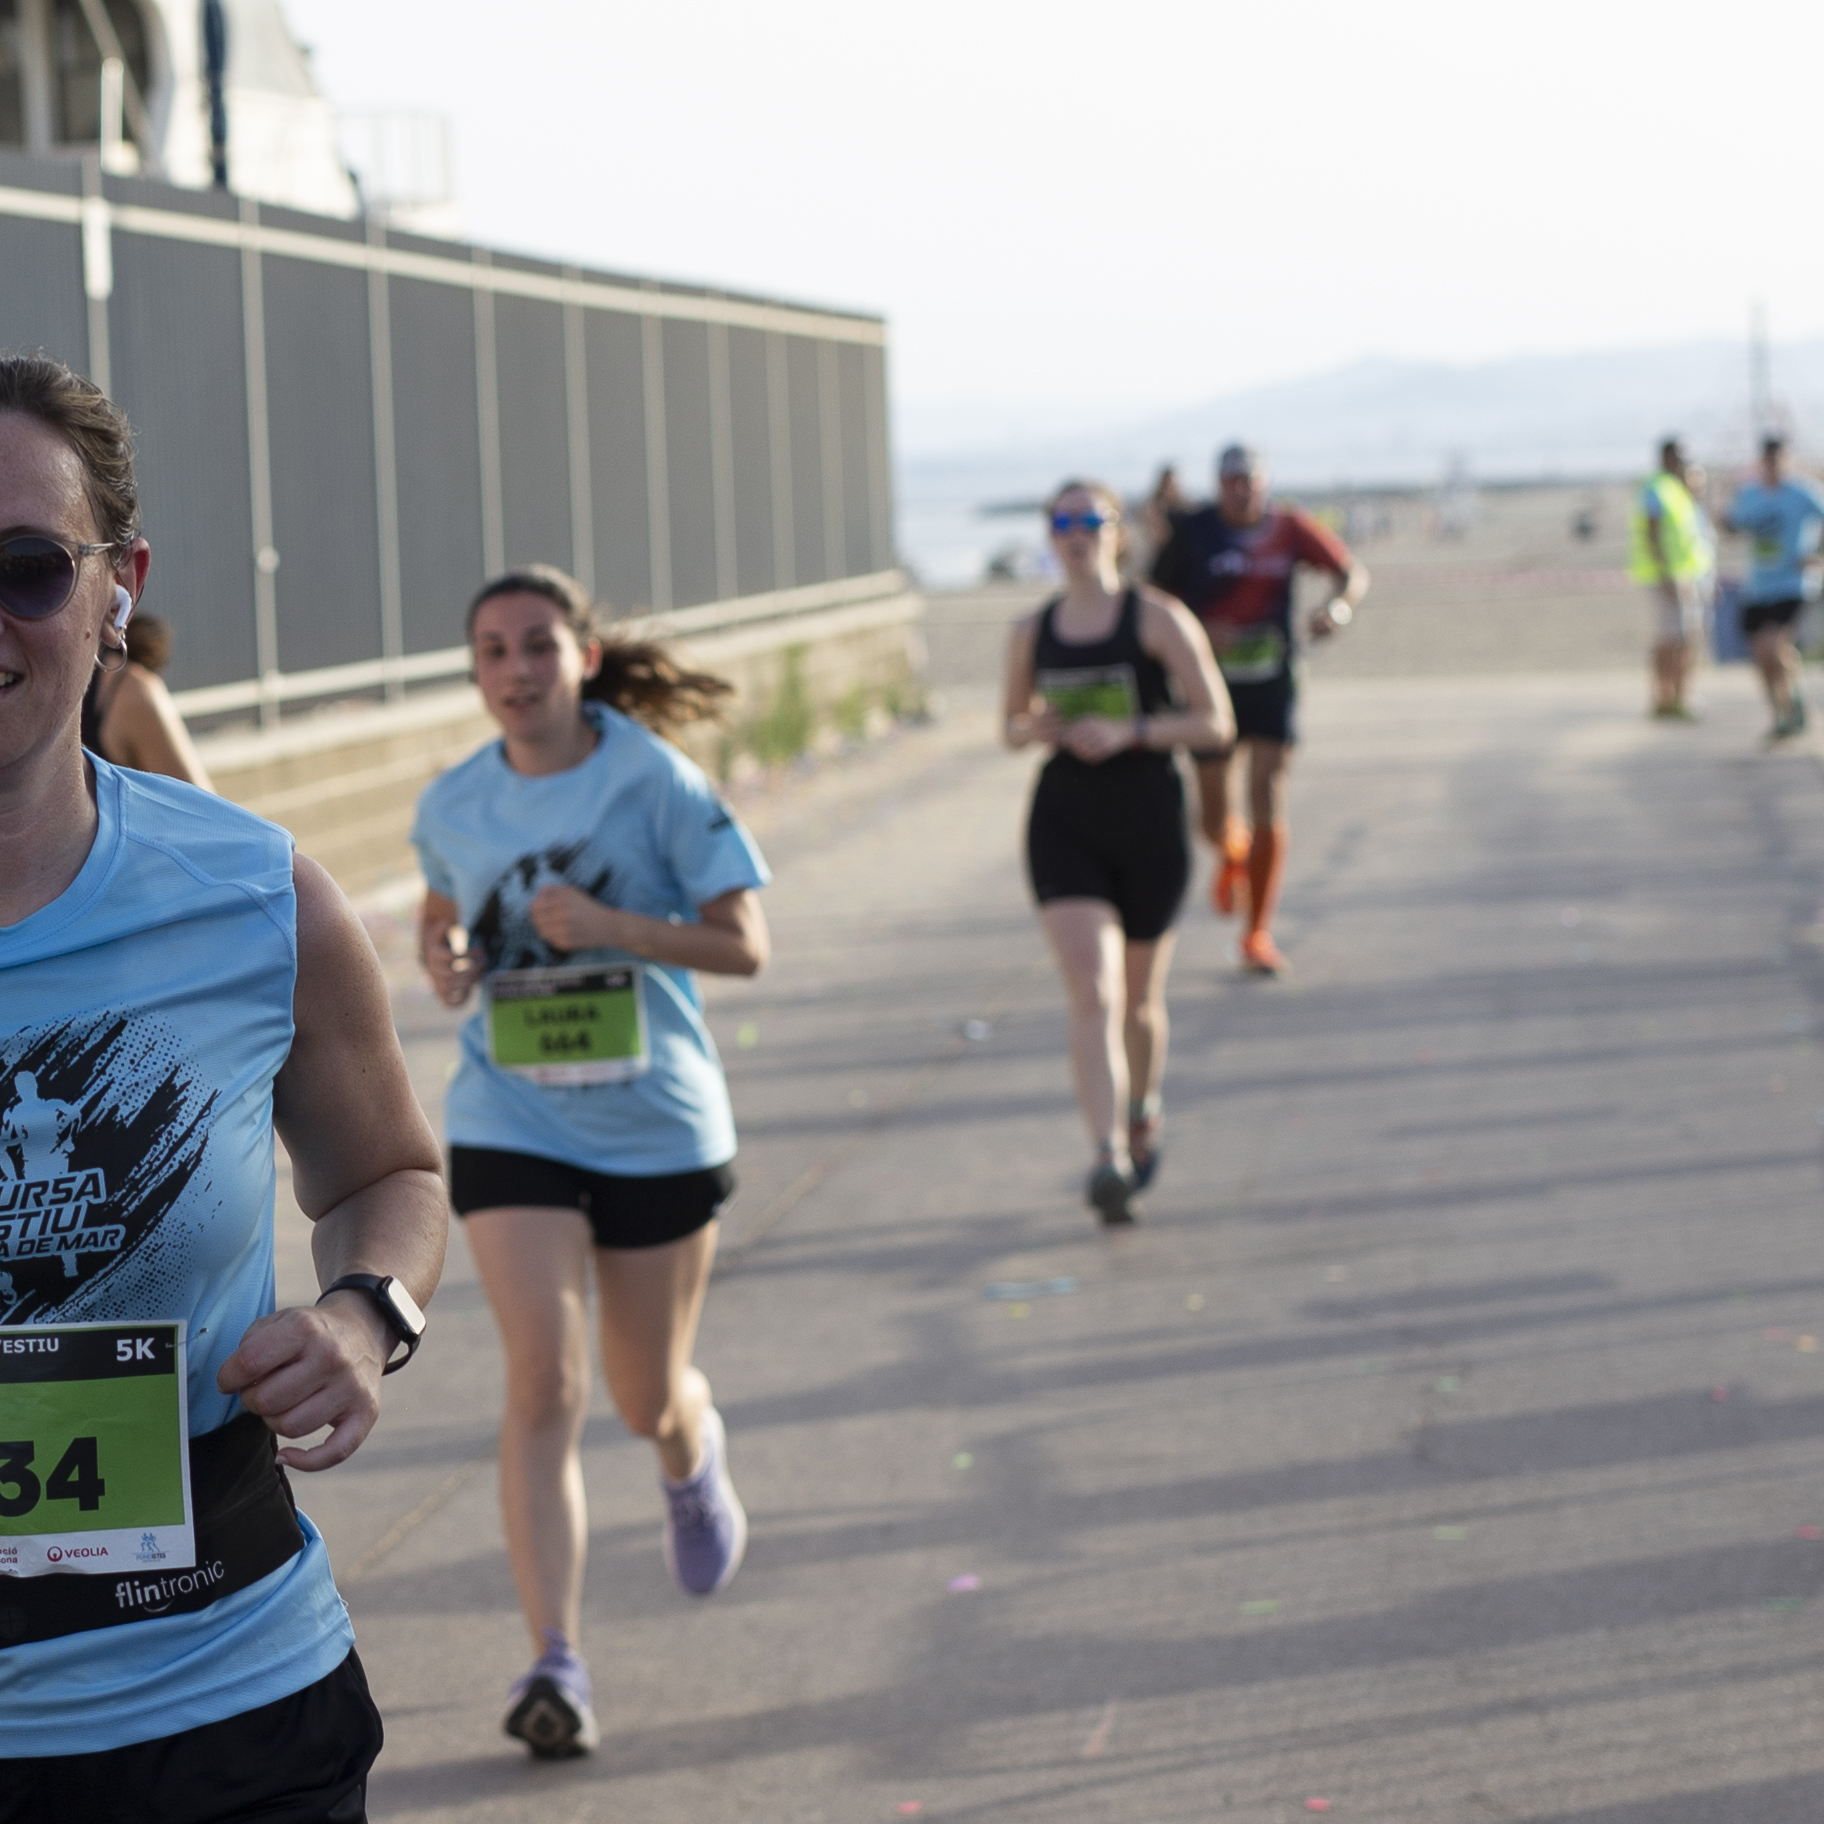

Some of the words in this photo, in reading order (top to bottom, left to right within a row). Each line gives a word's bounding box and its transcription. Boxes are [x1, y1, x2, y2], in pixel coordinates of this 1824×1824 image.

[16, 1237, 53, 1255] DE
[57, 1229, 121, 1252] MAR
[116, 1337, 156, 1362] 5K
[64, 1547, 109, 1559] VEOLIA
[115, 1561, 225, 1609] flintronic
